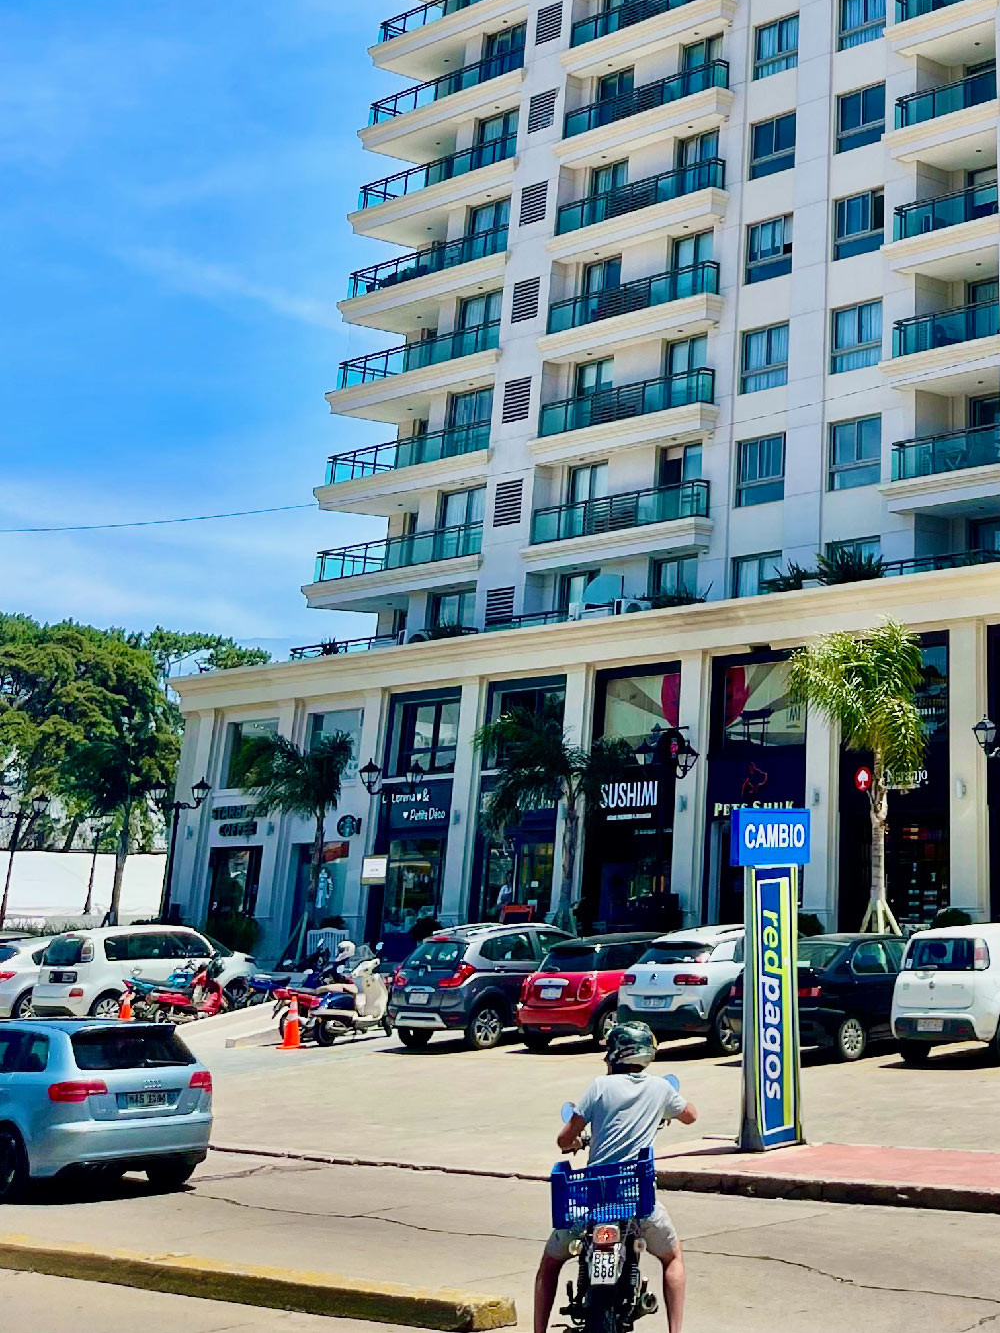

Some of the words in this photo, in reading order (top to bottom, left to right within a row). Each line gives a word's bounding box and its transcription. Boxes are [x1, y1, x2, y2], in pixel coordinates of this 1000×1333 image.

[600, 780, 658, 808] SUSHIMI
[744, 823, 805, 849] CAMBIO
[763, 908, 782, 1100] redpagos
